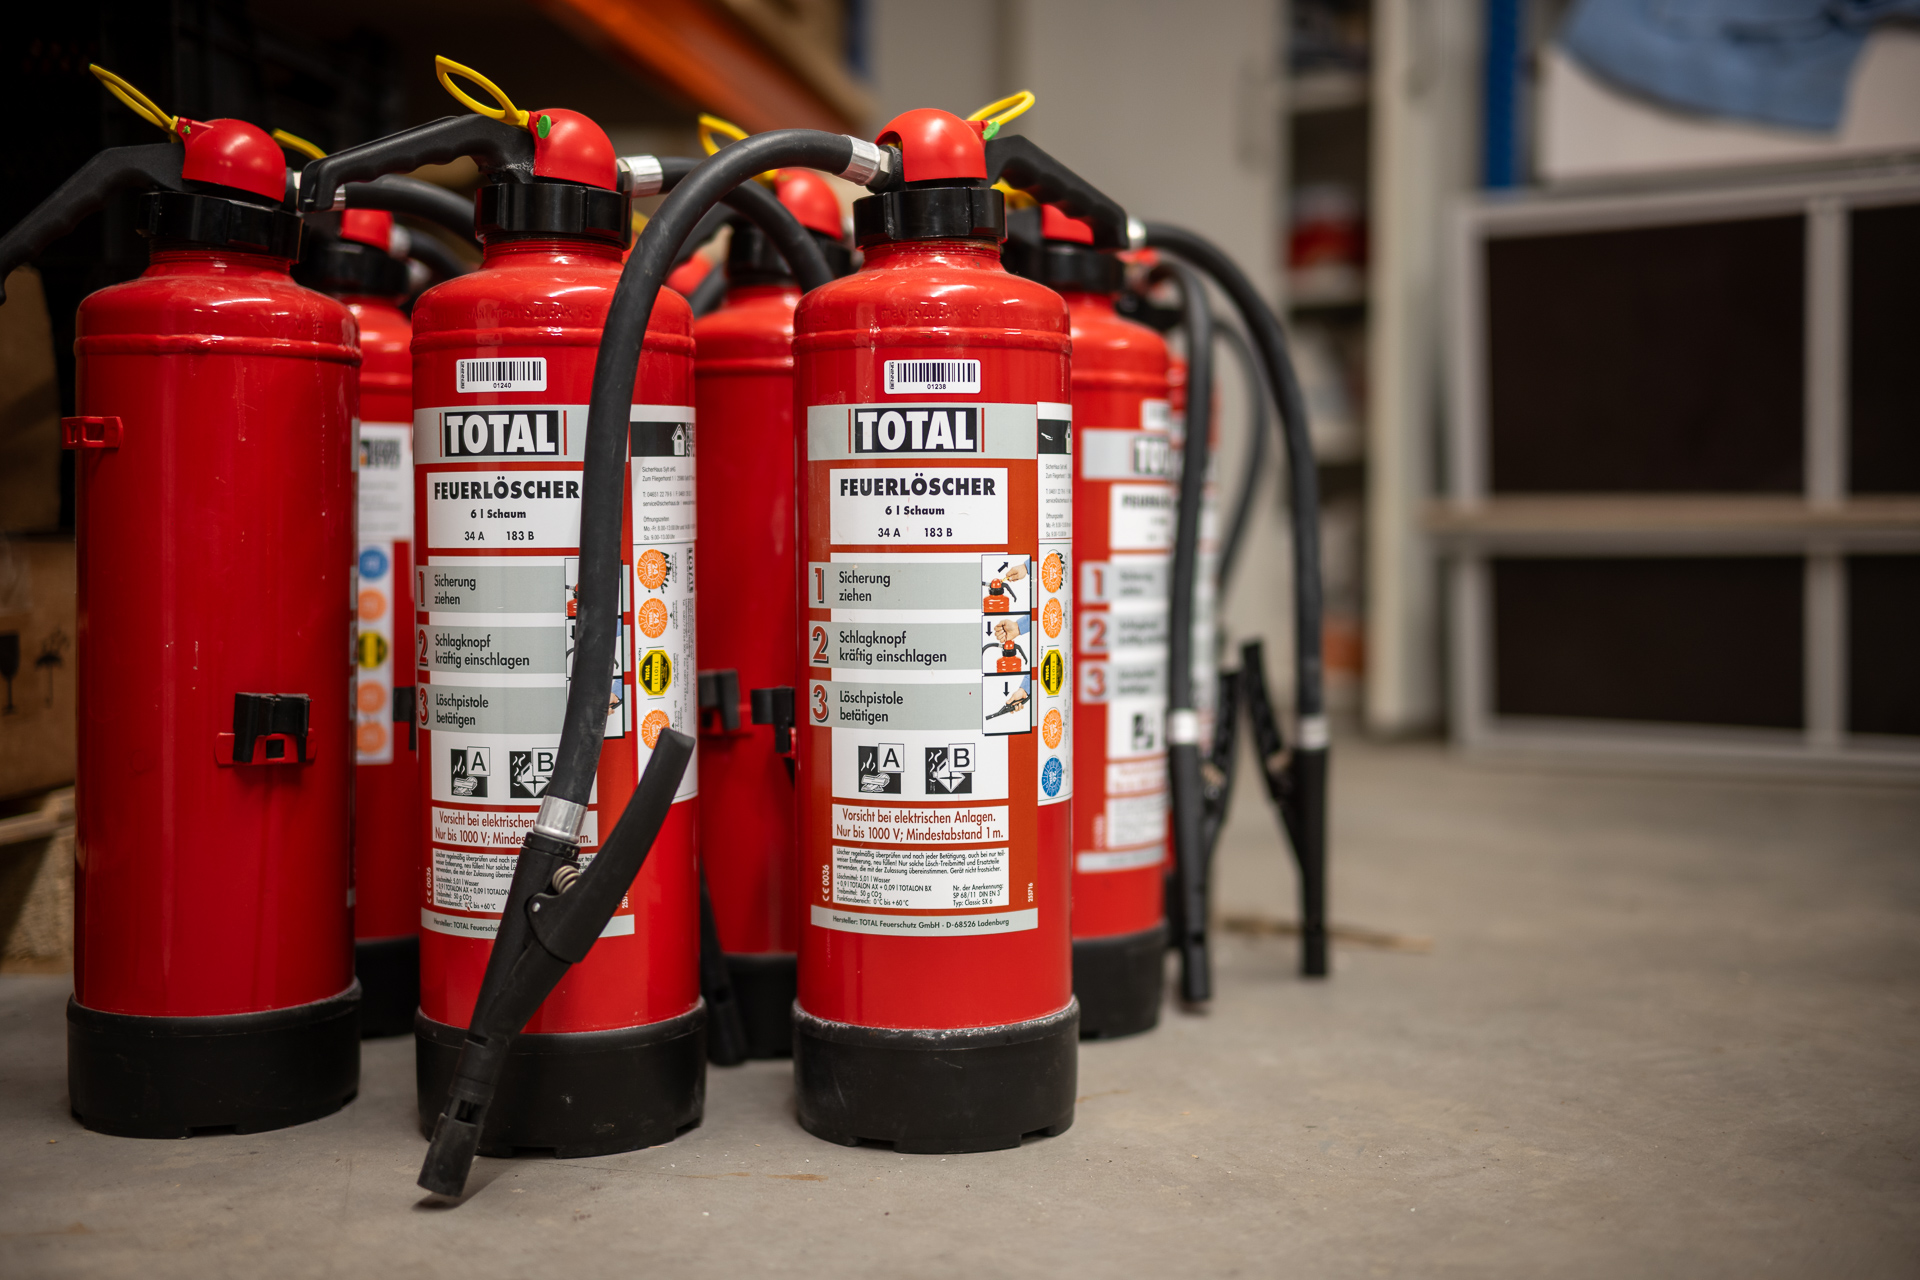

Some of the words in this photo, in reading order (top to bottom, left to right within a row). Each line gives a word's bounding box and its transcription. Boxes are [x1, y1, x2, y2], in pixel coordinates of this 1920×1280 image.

[447, 414, 556, 454] TOTAL
[857, 411, 974, 451] TOTAL
[434, 476, 580, 499] FEUERLÖSCHER
[840, 473, 997, 496] FEUERLÖSCHER
[471, 510, 477, 518] 6
[487, 509, 527, 519] Schaum
[885, 506, 892, 515] 6
[904, 506, 945, 515] Schaum
[464, 531, 477, 541] 34
[478, 531, 485, 541] A
[506, 531, 524, 541] 183
[527, 531, 535, 541] B
[878, 528, 890, 538] 34
[893, 528, 901, 538] A
[924, 528, 942, 538] 183
[946, 528, 953, 538] B
[434, 574, 476, 590] Sicherung
[815, 568, 824, 603] 1
[838, 570, 891, 587] Sicherung
[417, 571, 425, 607] 1
[838, 590, 872, 602] ziehen
[434, 592, 461, 606] ziehen
[435, 634, 491, 651] Schlagknopf
[839, 631, 906, 646] Schlagknopf
[1088, 619, 1107, 648] 2
[418, 629, 429, 667] 2
[812, 626, 829, 664] 2
[435, 652, 462, 670] kräftig
[465, 655, 530, 672] einschlagen
[839, 648, 872, 665] kräftig
[876, 650, 947, 666] einschlagen
[1088, 668, 1106, 697] 3
[419, 688, 430, 726] 3
[436, 693, 489, 711] Löschpistole
[812, 684, 828, 722] 3
[839, 690, 904, 707] Löschpistole
[436, 713, 476, 729] betätigen
[839, 708, 888, 725] betätigen
[471, 752, 487, 771] A
[537, 755, 553, 773] B
[882, 748, 900, 767] A
[954, 748, 970, 767] B
[439, 811, 465, 828] Vorsicht
[467, 814, 479, 829] bei
[482, 815, 535, 831] elektrischen
[842, 808, 875, 822] Vorsicht
[878, 809, 891, 823] bei
[894, 810, 951, 824] elektrischen
[954, 811, 996, 825] Anlagen.
[435, 827, 447, 840] Nur
[449, 828, 458, 841] bis
[460, 831, 478, 843] 1000
[481, 832, 490, 845] V;
[580, 834, 592, 844] m.
[837, 824, 851, 837] Nur
[853, 825, 865, 838] bis
[868, 827, 890, 839] 1000
[893, 828, 903, 841] V;
[906, 826, 982, 840] Mindestabstand
[987, 826, 991, 838] 1
[993, 828, 1004, 838] m.
[876, 851, 900, 859] überprüfen
[926, 852, 938, 861] jeder
[940, 853, 966, 861] Betätigung,
[968, 850, 979, 858] auch
[822, 864, 830, 886] 0036
[884, 867, 907, 875] Zulassung
[961, 891, 976, 899] 68/11
[979, 890, 988, 898] DIN
[954, 900, 964, 908] Typ:
[454, 921, 468, 931] TOTAL
[470, 924, 499, 935] Feuerschu
[833, 915, 857, 925] Hersteller:
[859, 919, 878, 928] TOTAL
[880, 920, 916, 929] Feuerschutz
[919, 921, 940, 929] GmbH
[946, 920, 976, 929] D-68526
[978, 918, 1009, 928] Ladenburg
